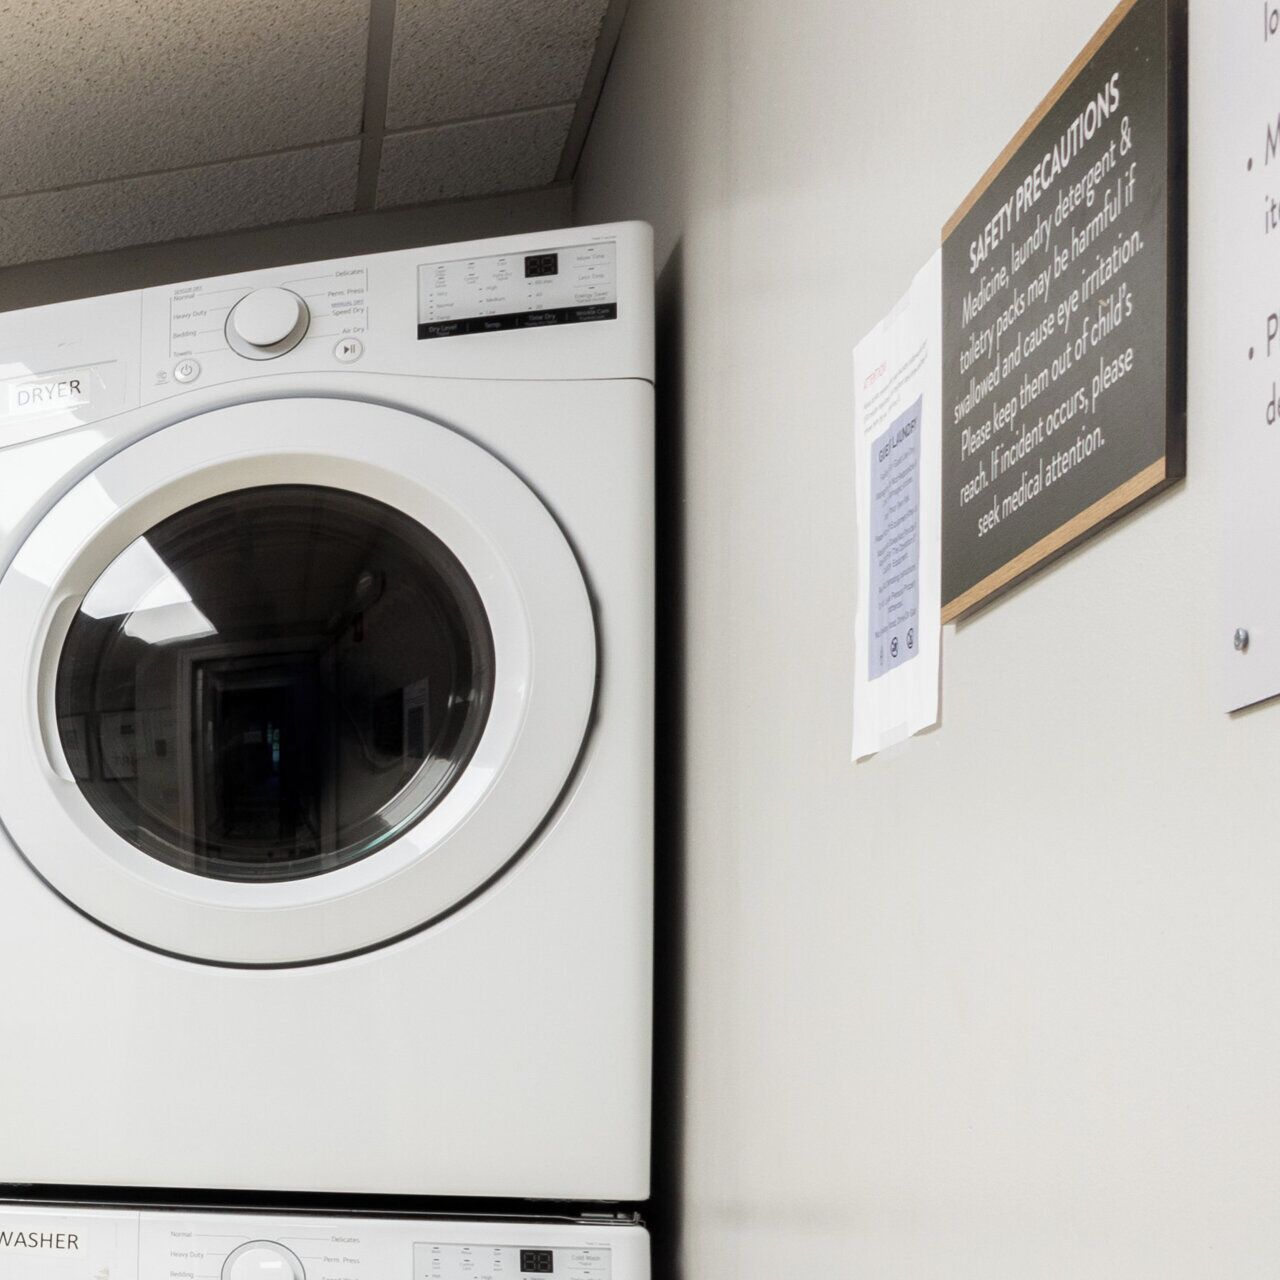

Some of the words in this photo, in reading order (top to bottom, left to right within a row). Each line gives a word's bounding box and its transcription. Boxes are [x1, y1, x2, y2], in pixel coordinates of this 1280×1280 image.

[969, 196, 1013, 274] SAFETY
[1015, 72, 1120, 223] PRECAUTIONS
[962, 266, 1010, 329] Medicine,
[1011, 213, 1053, 275] laundry
[1054, 140, 1117, 227] detergent
[1119, 115, 1133, 156] &
[335, 268, 364, 277] Delicates
[959, 324, 995, 375] toiletry
[996, 287, 1026, 351] packs
[1027, 265, 1052, 307] may
[1053, 245, 1069, 279] be
[1071, 177, 1123, 262] harmful
[1124, 162, 1137, 207] if
[173, 293, 195, 302] Normal
[327, 290, 346, 298] Perm.
[347, 288, 364, 296] Press
[173, 310, 191, 320] Heavy
[192, 309, 207, 318] Duty
[332, 308, 351, 317] Speed
[352, 307, 364, 315] Dry
[352, 326, 364, 335] Dry
[953, 353, 1000, 424] swallowed
[1002, 331, 1021, 379] and
[1023, 312, 1055, 358] cause
[1057, 290, 1079, 334] eye
[1081, 230, 1144, 303] irritation.
[173, 330, 197, 339] Bedding
[961, 420, 991, 462] Please
[992, 396, 1017, 433] keep
[1019, 367, 1049, 410] them
[1051, 342, 1072, 381] out
[1074, 317, 1089, 361] of
[1091, 282, 1133, 346] child's
[17, 379, 81, 406] DRYER
[960, 461, 989, 507] reach.
[991, 445, 1000, 482] If
[1000, 417, 1044, 474] incident
[1045, 387, 1089, 436] occurs,
[1091, 347, 1135, 414] please
[977, 494, 1001, 537] seek
[1001, 458, 1043, 519] medical
[1044, 425, 1105, 487] attention.
[170, 1230, 192, 1238] Normal
[170, 1251, 188, 1259] Heavy
[189, 1251, 204, 1260] Duty
[170, 1271, 194, 1280] Bedding
